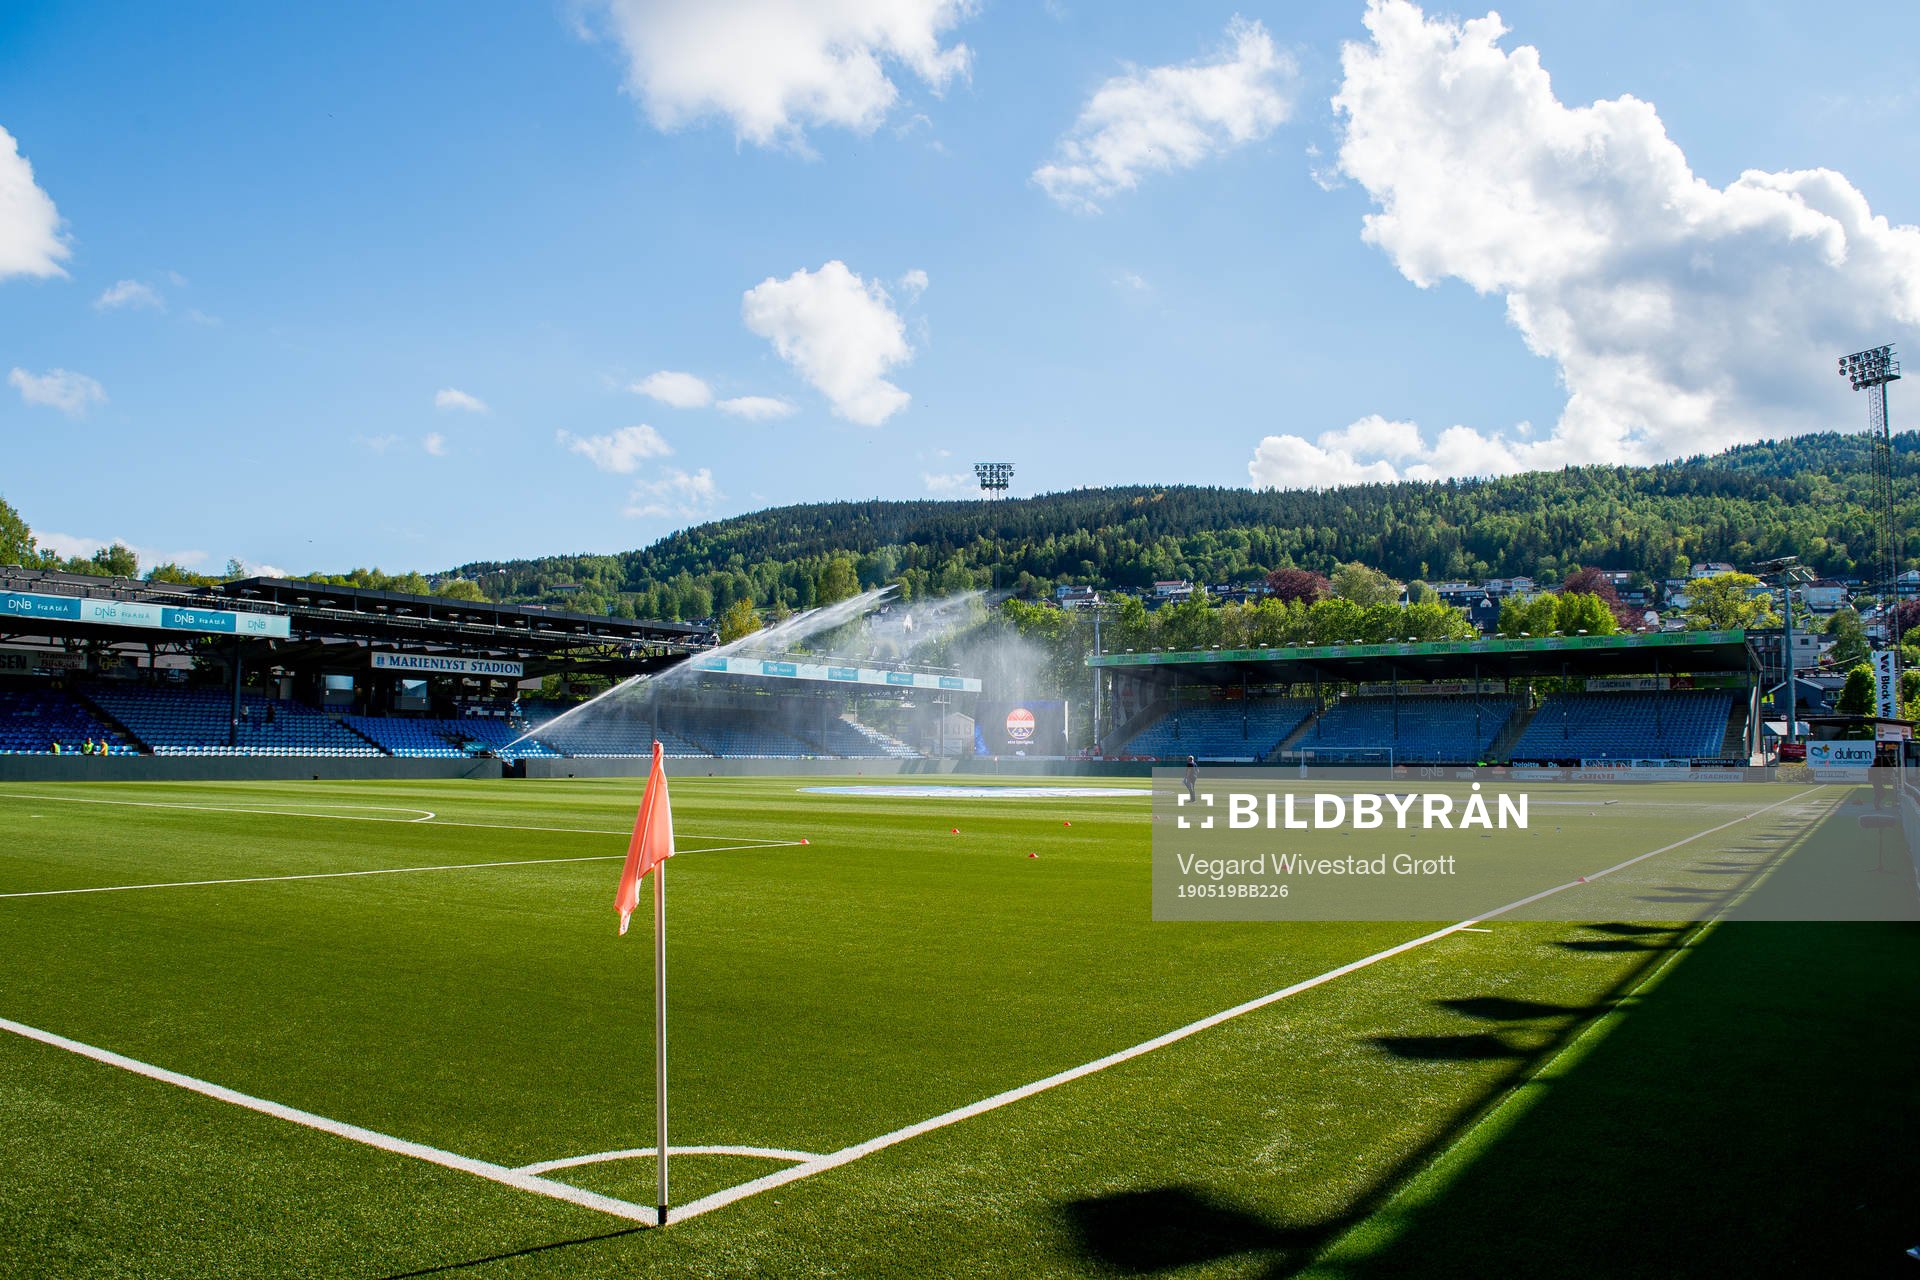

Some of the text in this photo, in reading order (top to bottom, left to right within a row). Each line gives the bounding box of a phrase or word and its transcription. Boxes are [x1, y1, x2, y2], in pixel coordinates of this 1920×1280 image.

[8, 598, 32, 611] DNB
[95, 606, 117, 619] DNB
[174, 612, 195, 625] DNB
[248, 618, 266, 630] DNB
[389, 655, 521, 674] MARIENLYST STADION
[1881, 675, 1890, 700] Block
[1420, 764, 1444, 779] DNB
